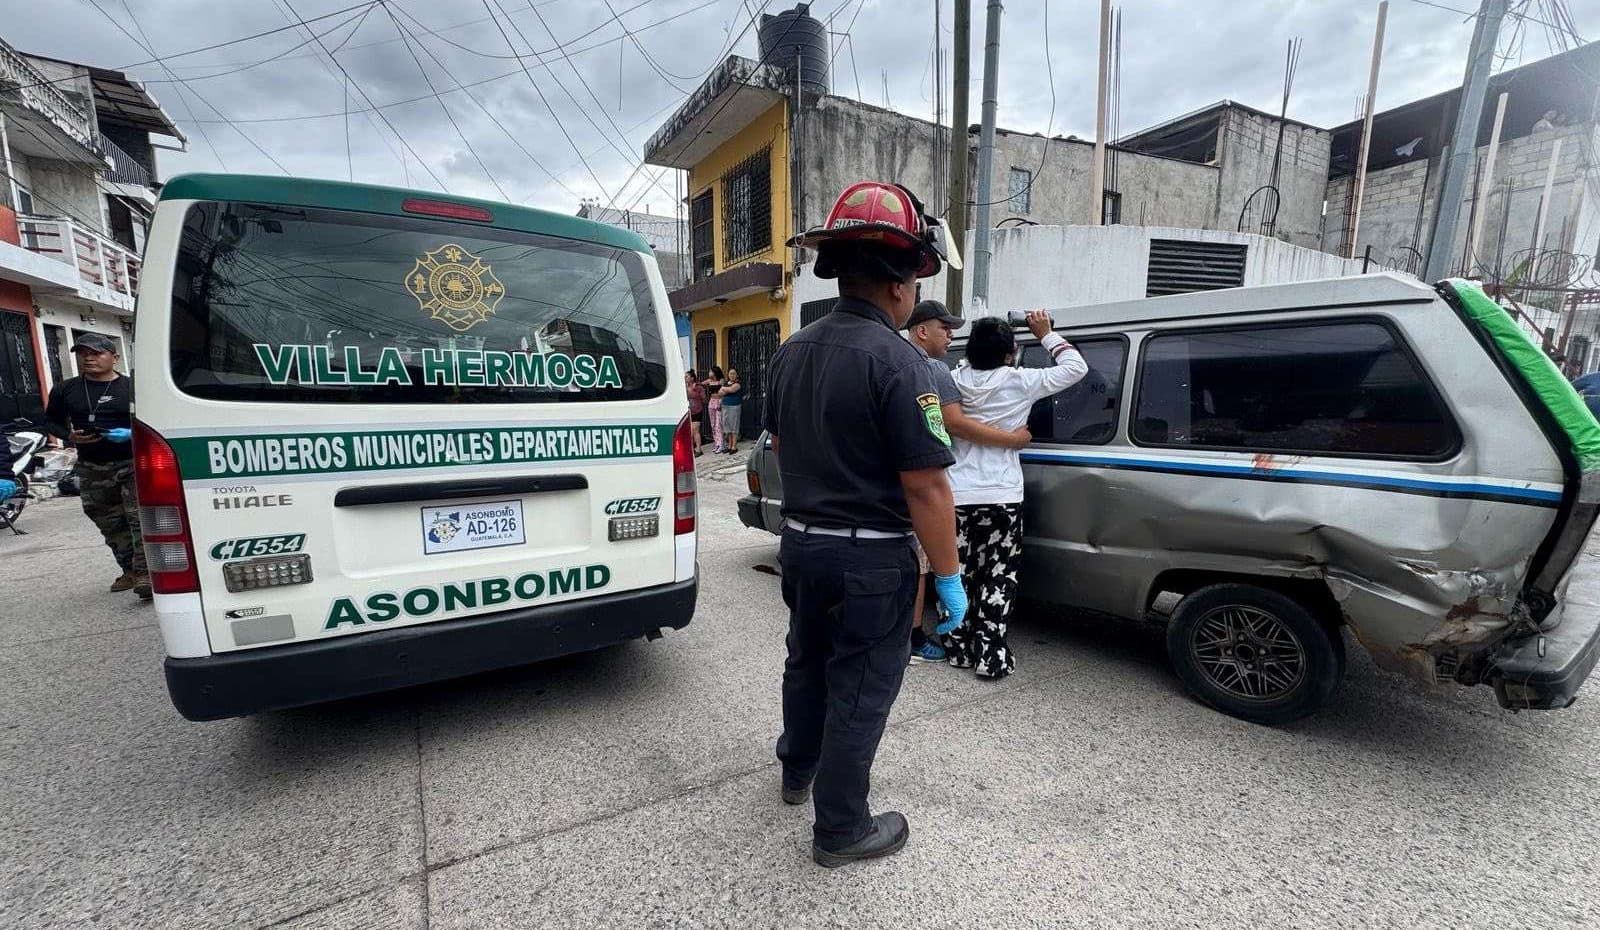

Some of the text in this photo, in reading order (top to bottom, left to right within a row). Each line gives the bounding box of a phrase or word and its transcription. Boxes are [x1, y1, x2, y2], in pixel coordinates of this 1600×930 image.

[253, 344, 623, 389] VILLA HERMOSA
[207, 427, 659, 474] BOMBEROS MUNICIPALES DEPARTAMENTALES
[213, 485, 257, 495] TOYOTA
[213, 494, 293, 510] HIACE
[465, 509, 515, 521] ASONBOMD
[467, 517, 517, 536] AD-126
[323, 563, 612, 631] ASONBOMD
